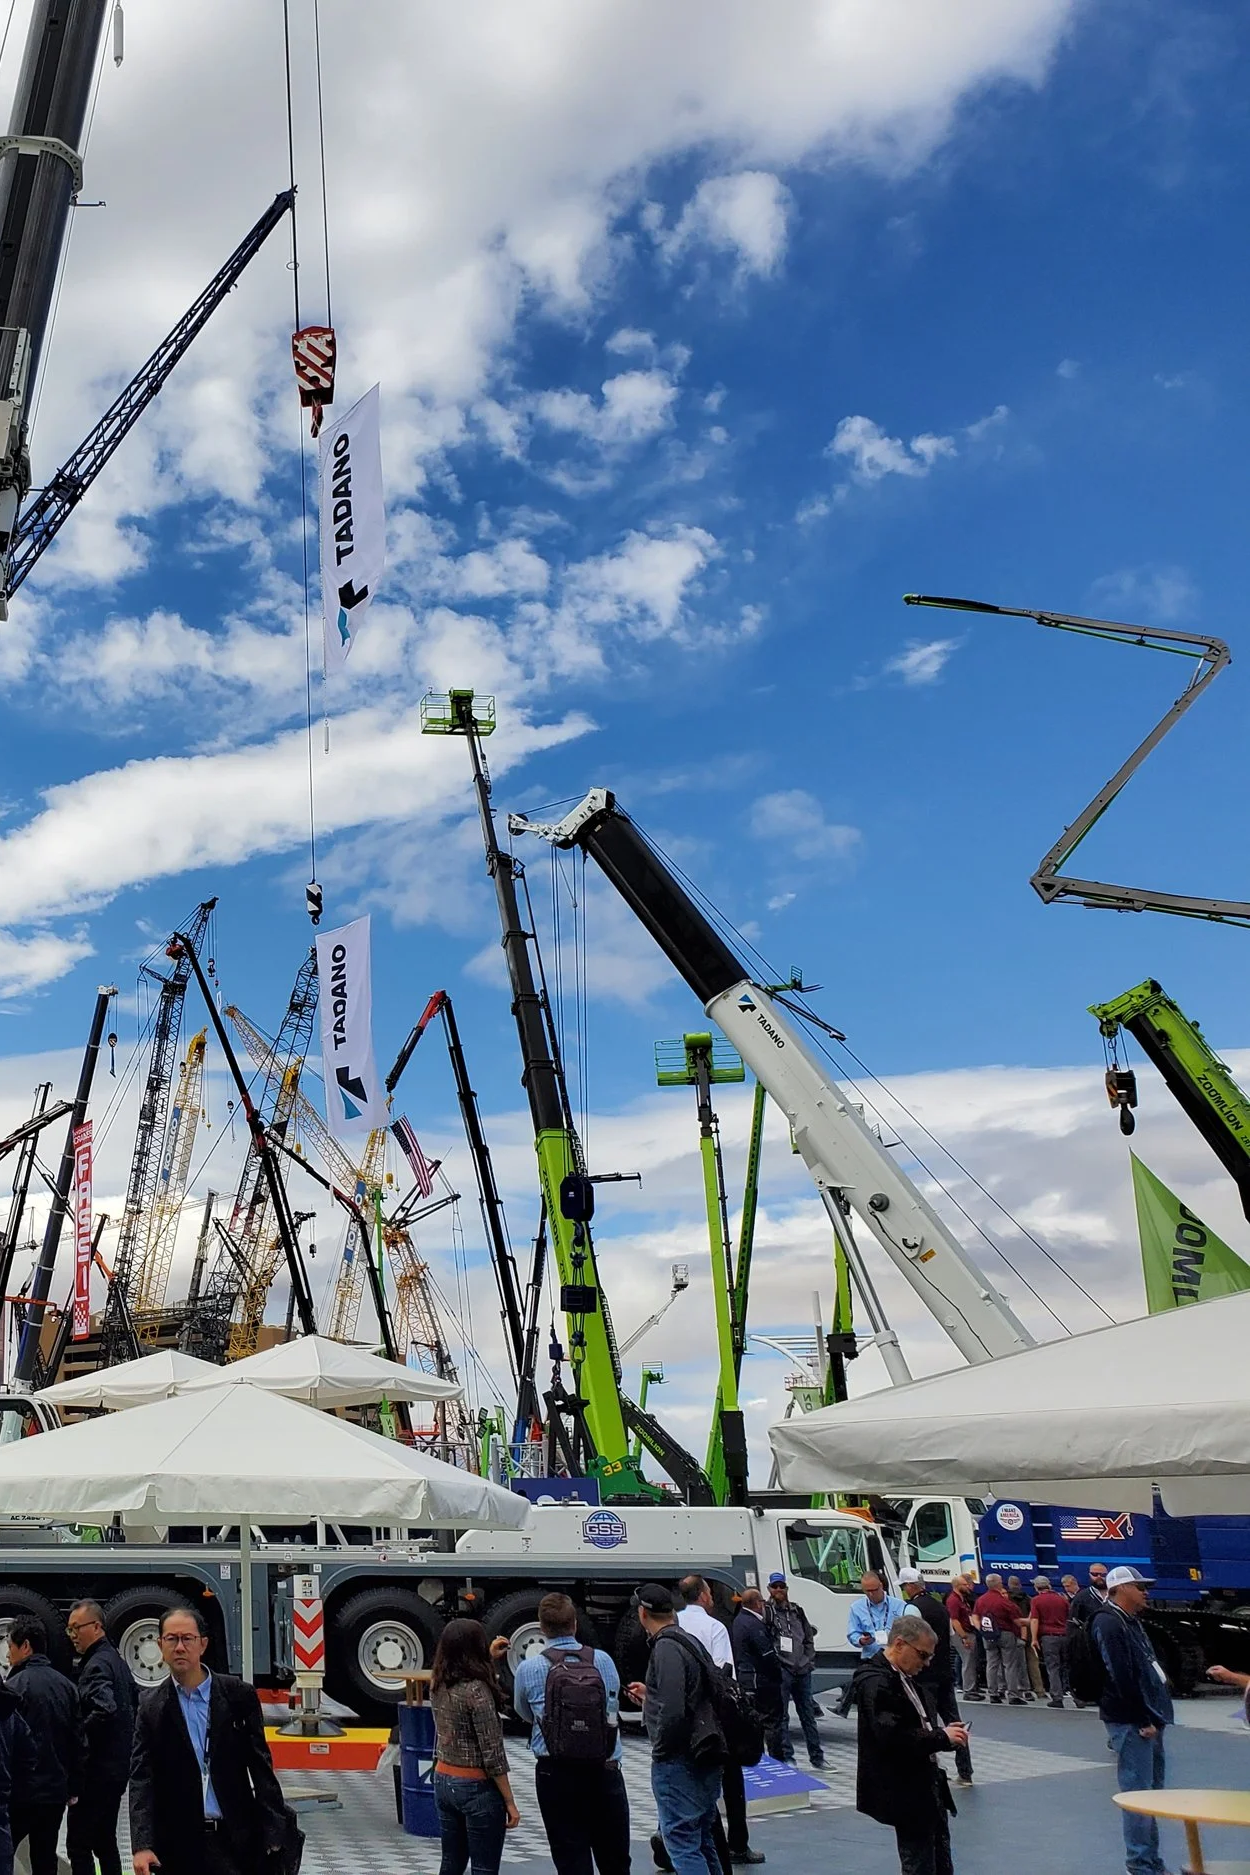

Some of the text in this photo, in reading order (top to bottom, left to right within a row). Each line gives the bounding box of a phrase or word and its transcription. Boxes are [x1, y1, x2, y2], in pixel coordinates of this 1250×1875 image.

[332, 432, 354, 567] TADANO
[331, 944, 348, 1051] TADANO
[757, 1013, 785, 1048] TADANO
[1196, 1074, 1243, 1131] ZOOMLION
[163, 1117, 178, 1167] KOBELCO
[77, 1152, 91, 1291] FASSI
[346, 1194, 362, 1250] KOBO
[543, 1166, 560, 1248] ZOOMLION
[634, 1423, 665, 1456] ZOOMLION
[602, 1460, 622, 1476] 33
[586, 1523, 623, 1535] GSS
[920, 1568, 950, 1576] MAXIM
[990, 1562, 1033, 1570] GTC-1300
